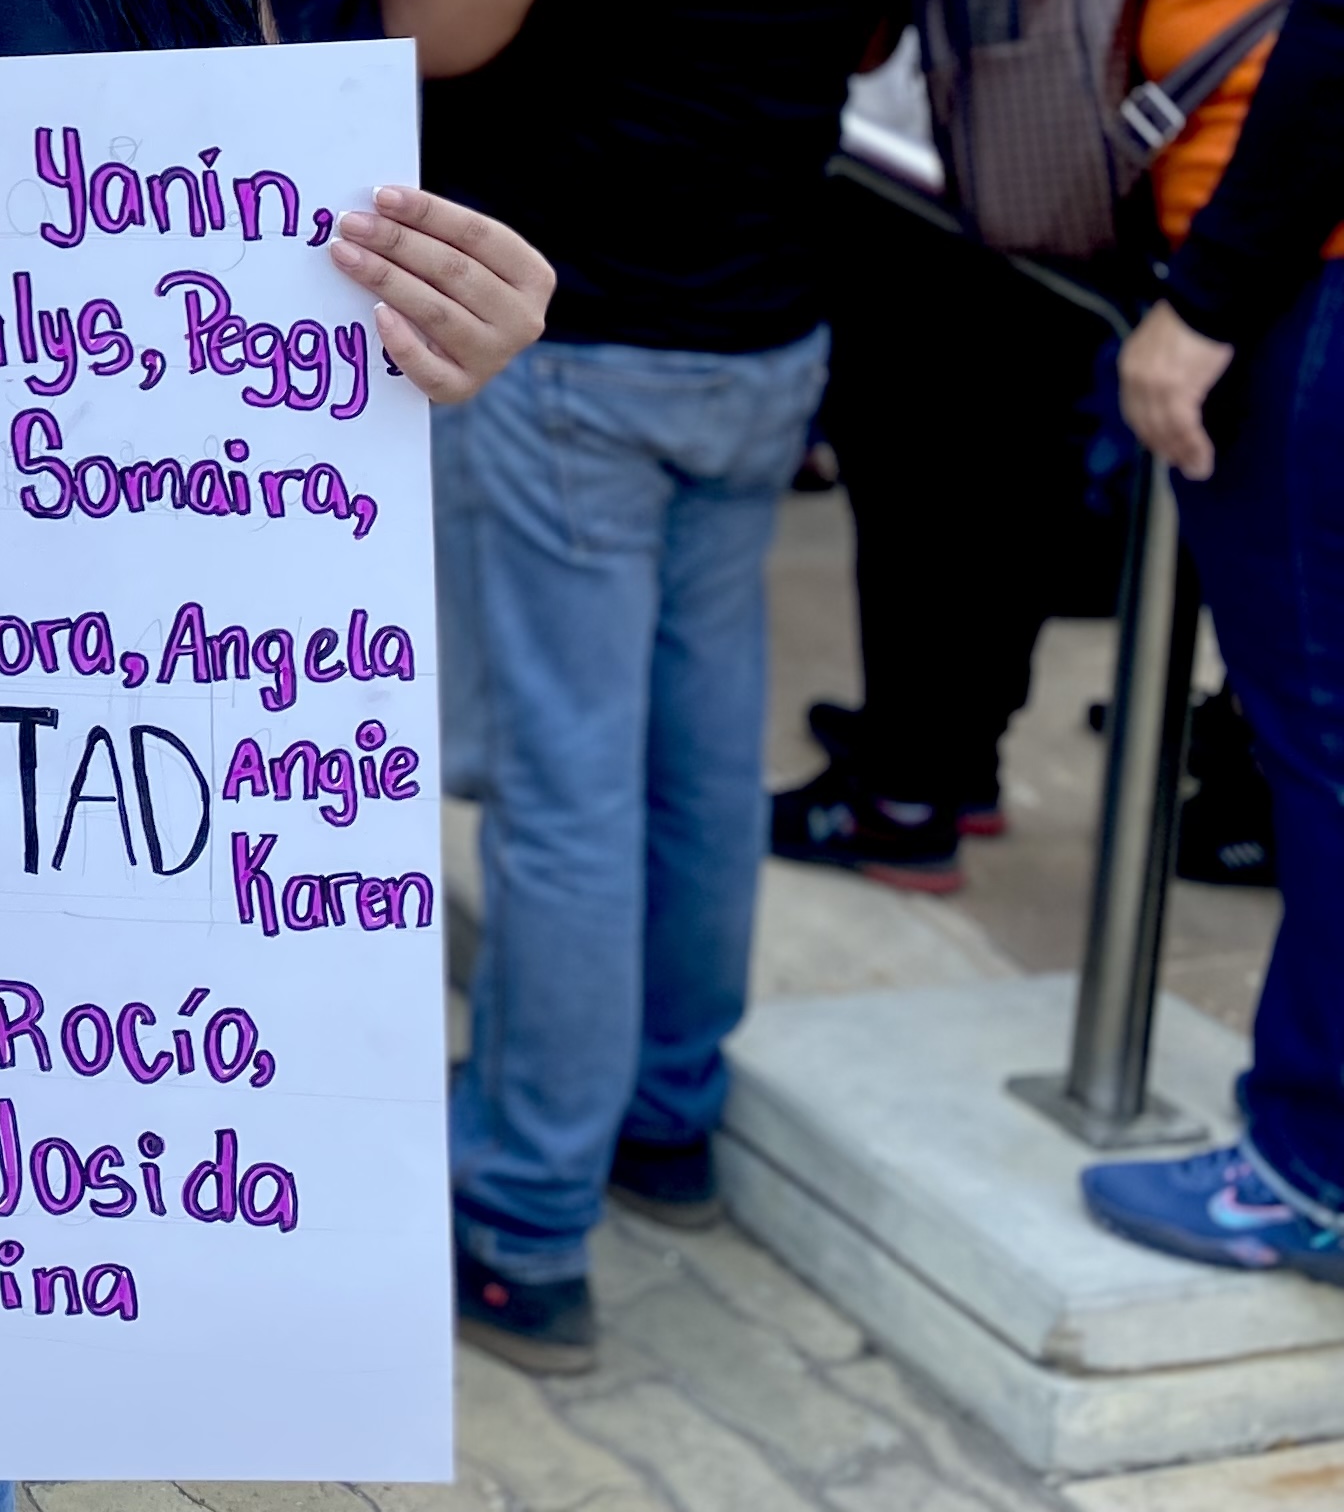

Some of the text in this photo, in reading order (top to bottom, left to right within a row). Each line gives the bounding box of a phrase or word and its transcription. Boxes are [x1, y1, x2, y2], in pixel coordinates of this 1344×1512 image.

[11, 407, 378, 540] Somaira,
[155, 601, 415, 713] Angela
[222, 718, 421, 827] Angie
[230, 832, 435, 938] Karen
